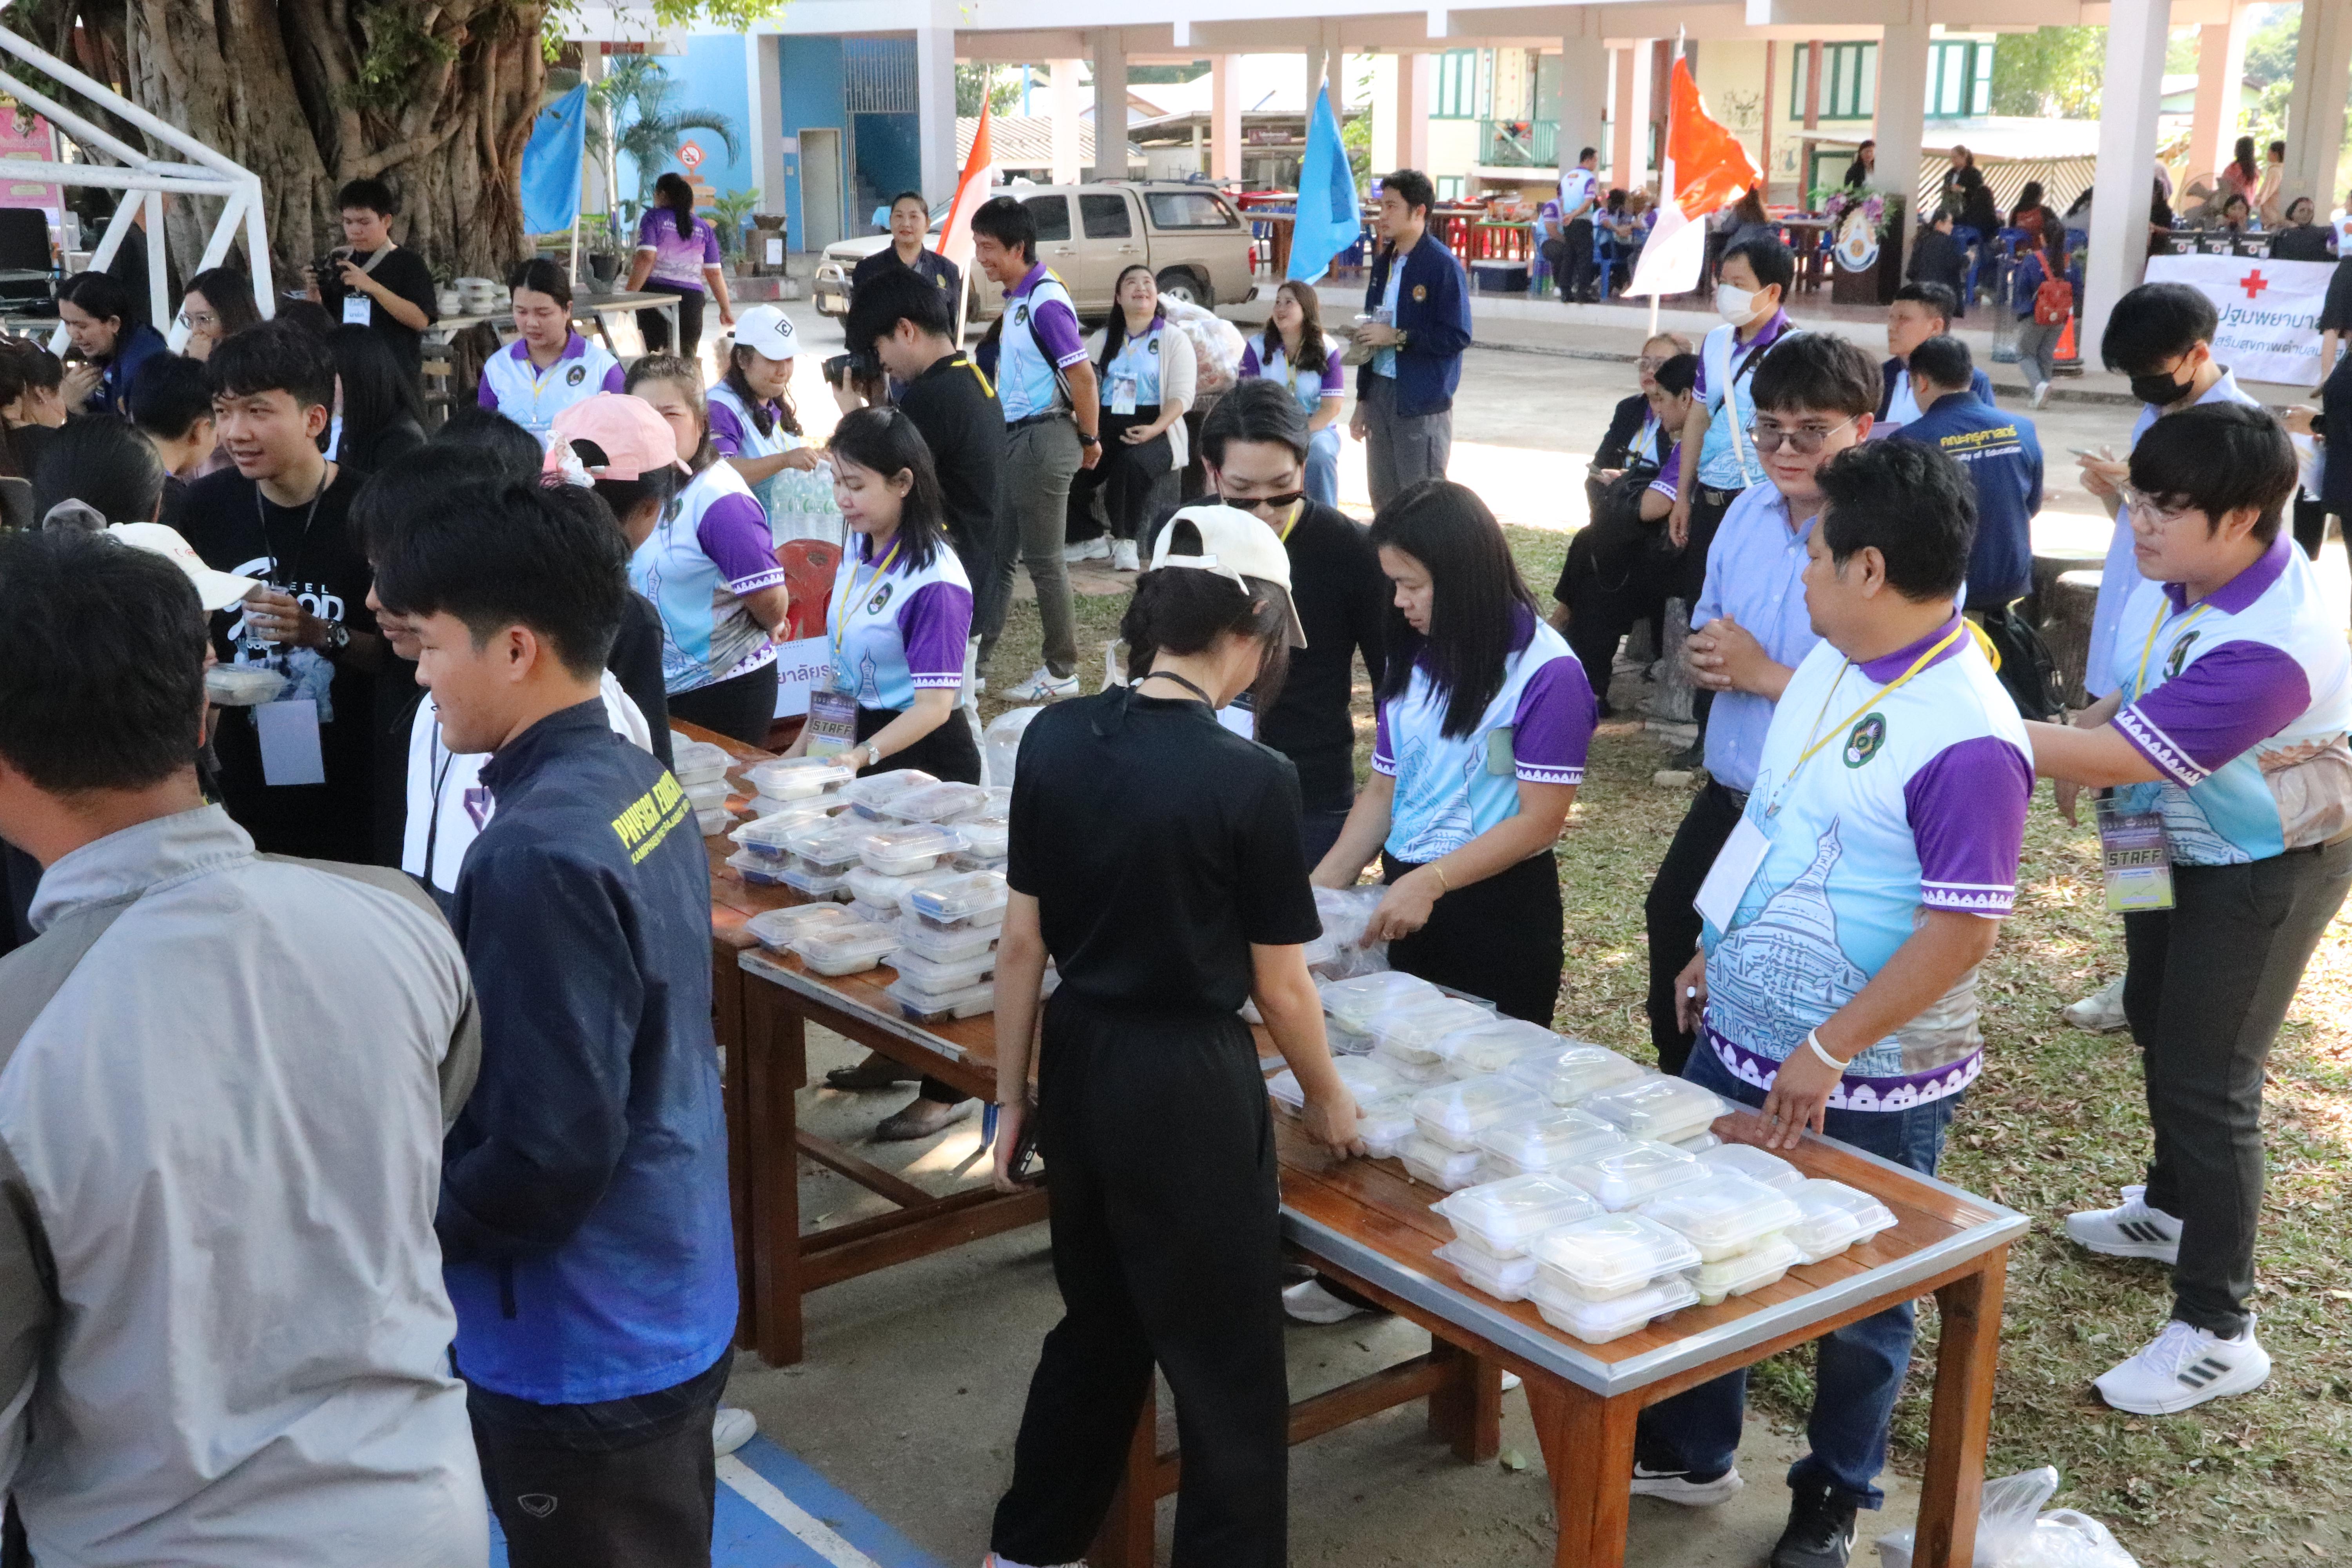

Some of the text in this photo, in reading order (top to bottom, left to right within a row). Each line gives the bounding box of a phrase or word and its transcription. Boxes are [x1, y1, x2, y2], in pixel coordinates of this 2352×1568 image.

[782, 323, 788, 333] C
[1940, 424, 2017, 447] คณะครุศาสตร์
[813, 720, 853, 735] STAFF
[2107, 849, 2162, 867] STAFF
